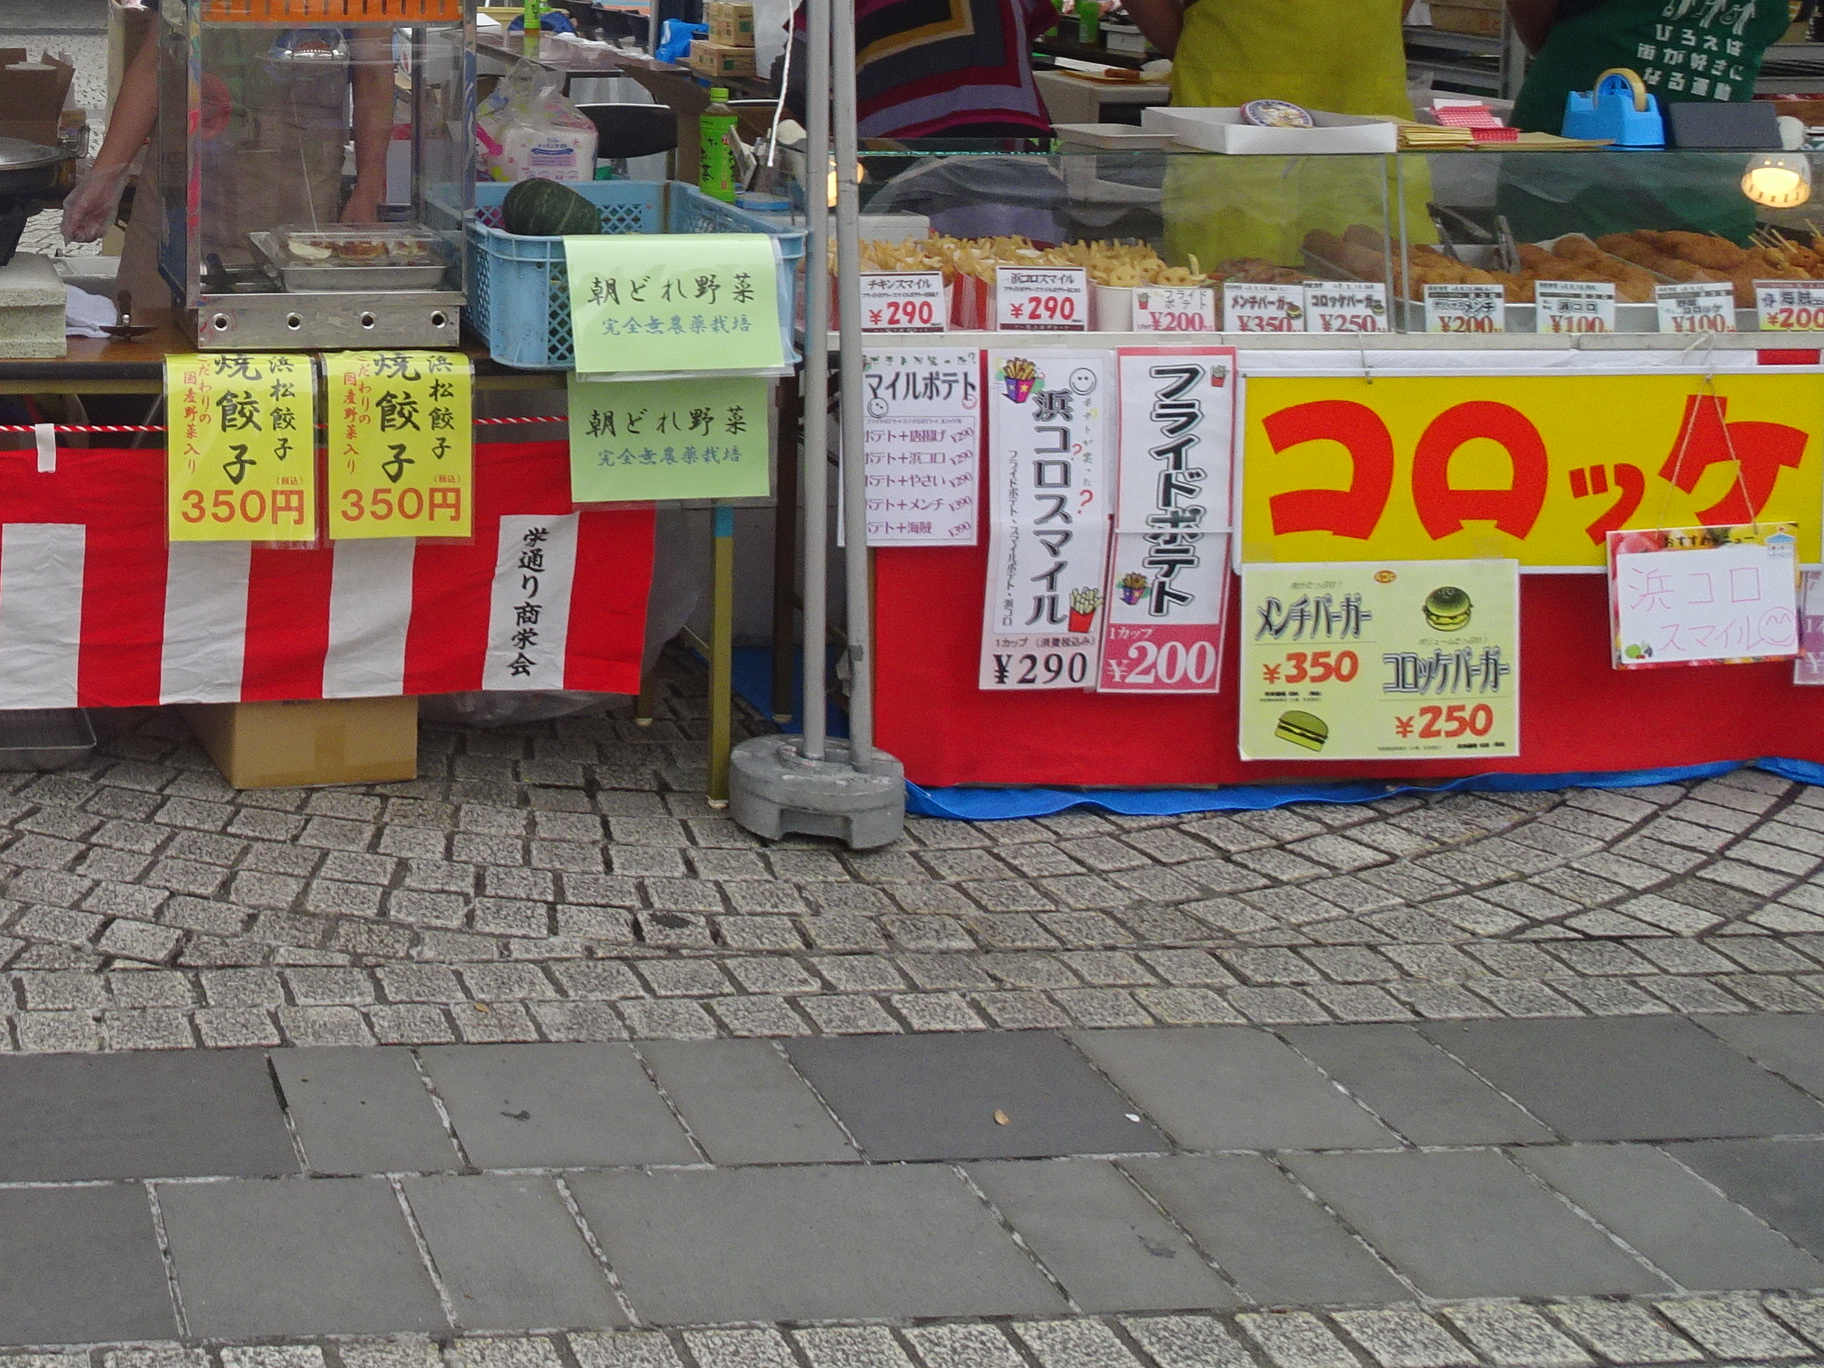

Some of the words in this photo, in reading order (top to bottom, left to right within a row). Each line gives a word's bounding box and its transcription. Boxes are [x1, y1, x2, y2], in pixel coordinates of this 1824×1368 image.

[587, 272, 755, 306] 朝どれ野菜
[602, 314, 753, 336] 完全無農薬栽培
[869, 300, 934, 326] ¥290
[1010, 295, 1076, 320] ¥290
[1150, 311, 1205, 332] ¥200
[1237, 314, 1293, 332] ¥350
[1319, 313, 1376, 332] ¥250
[1438, 315, 1494, 332] ¥200
[1549, 314, 1605, 332] ¥100
[1671, 313, 1726, 333] ¥100
[183, 371, 201, 475] 国産野菜入り
[214, 353, 263, 485] 焼餃子
[268, 356, 297, 461] 浜松餃子
[342, 372, 360, 475] 国産野菜入り
[373, 352, 422, 484] 焼餃子
[426, 354, 455, 460] 浜松餃子
[585, 404, 748, 438] 朝どれ野菜
[597, 444, 742, 468] 完全無農薬栽培
[1262, 394, 1809, 546] コロッケ
[181, 489, 305, 525] 350円
[340, 486, 461, 522] 350円
[1026, 388, 1074, 627] 浜コロスマイル
[1143, 363, 1208, 617] フライドポテト
[1628, 566, 1762, 612] 浜コロ
[1254, 593, 1373, 641] メンチバーガー
[1658, 614, 1766, 652] スマイル
[993, 652, 1088, 685] ¥290
[1107, 641, 1217, 685] ¥200
[1263, 650, 1360, 685] ¥350
[1381, 645, 1511, 695] コロッケバーガー
[1395, 703, 1494, 740] ¥250
